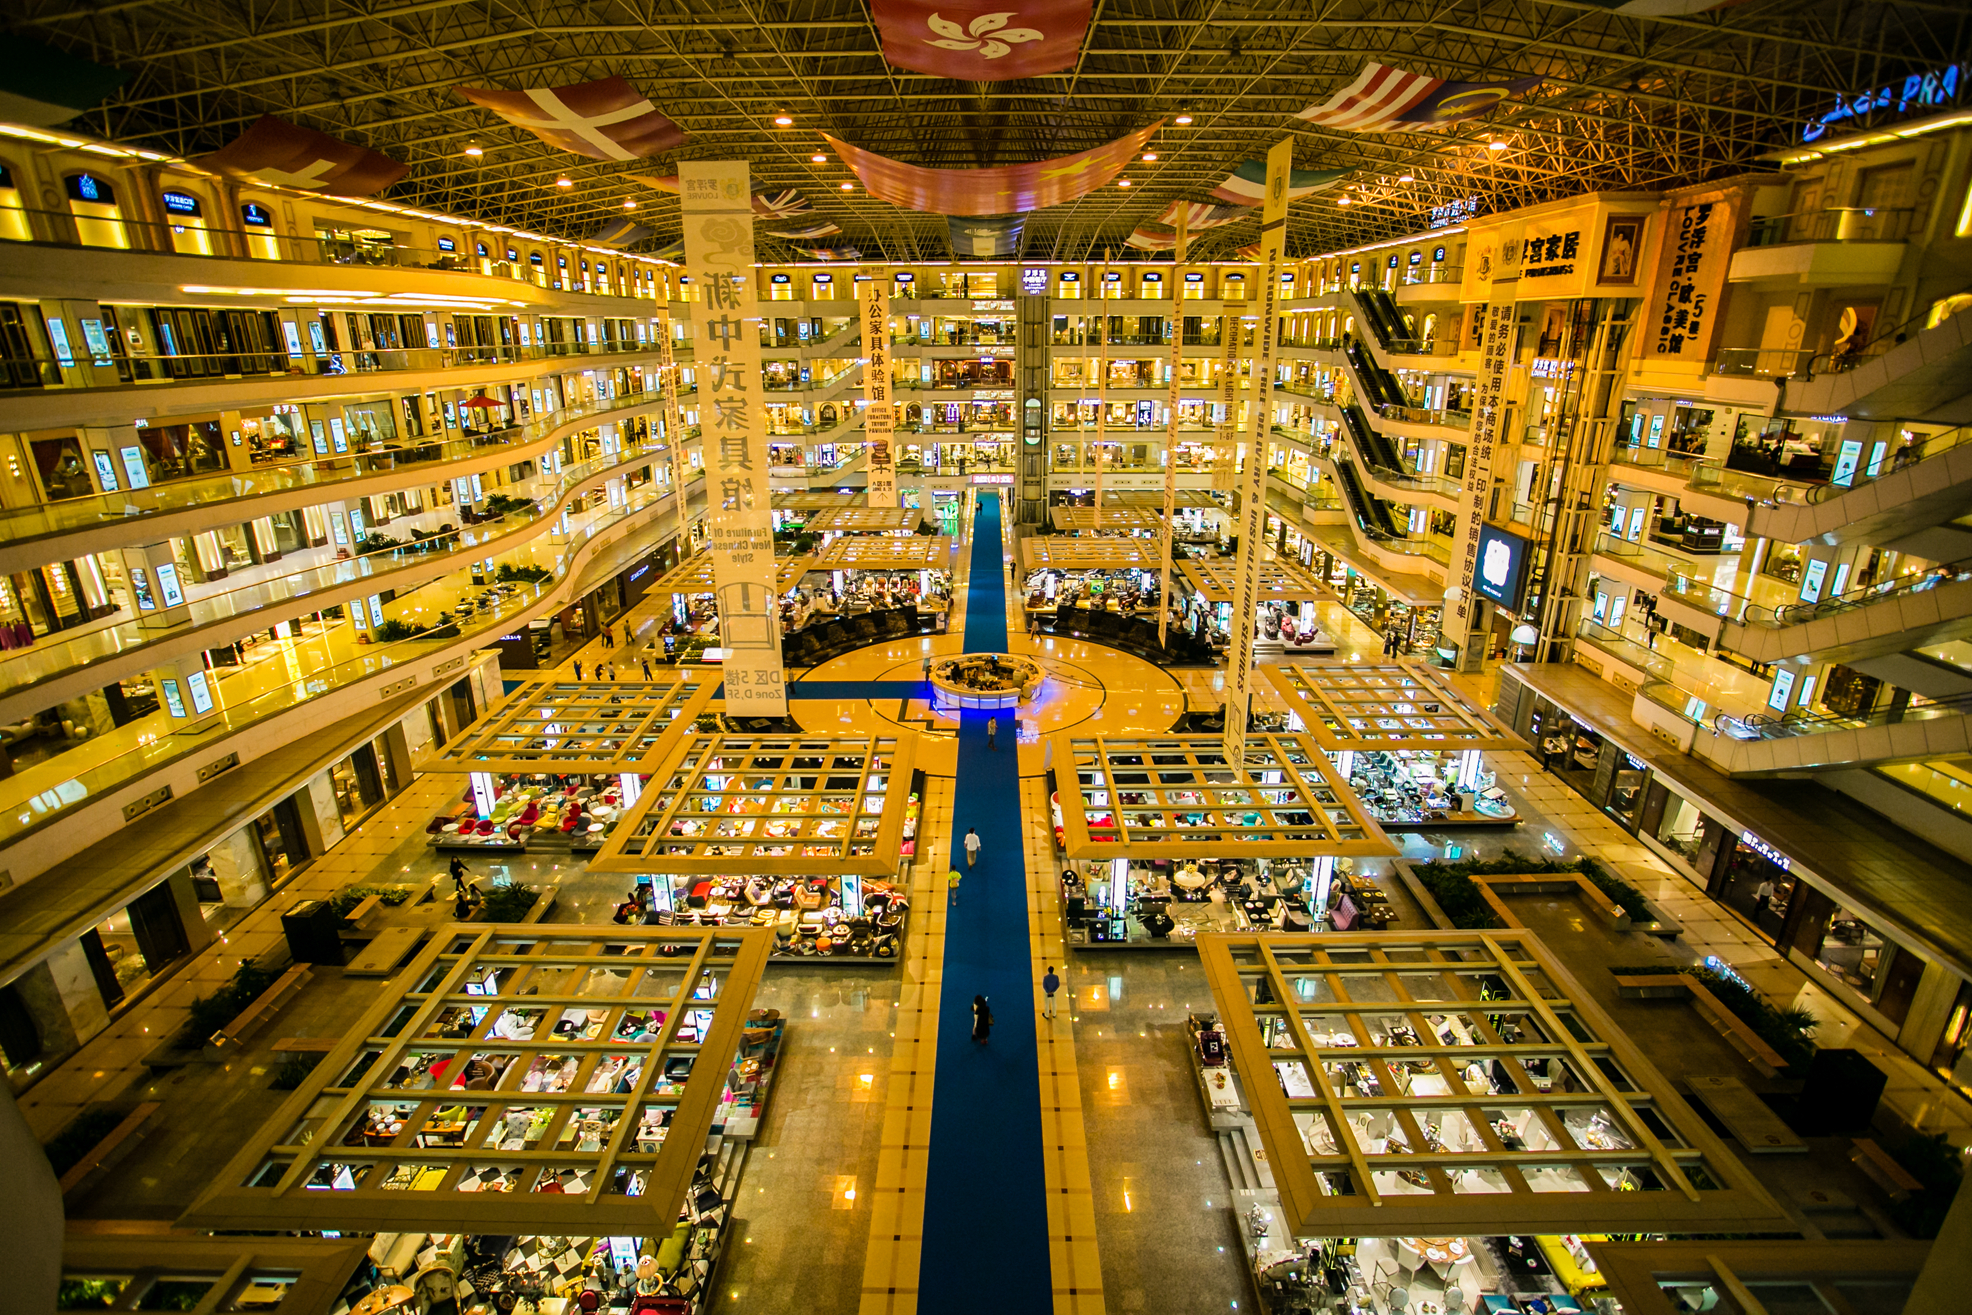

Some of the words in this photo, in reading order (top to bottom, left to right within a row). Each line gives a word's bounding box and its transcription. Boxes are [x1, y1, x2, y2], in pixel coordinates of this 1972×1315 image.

[1262, 247, 1277, 361] NATIONWIDE
[868, 288, 885, 401] 办公家具体验馆
[1226, 316, 1239, 372] DECORATIONS
[1225, 381, 1235, 421] LIGHTINGS
[1259, 367, 1268, 407] FREE
[1252, 412, 1265, 489] DELIVERY
[1456, 305, 1512, 619] 请务必使用本商场统一印制的销售协议开单
[1251, 492, 1259, 504] &
[1243, 509, 1258, 621] INSTALLATION
[1237, 622, 1249, 694] SERVICES
